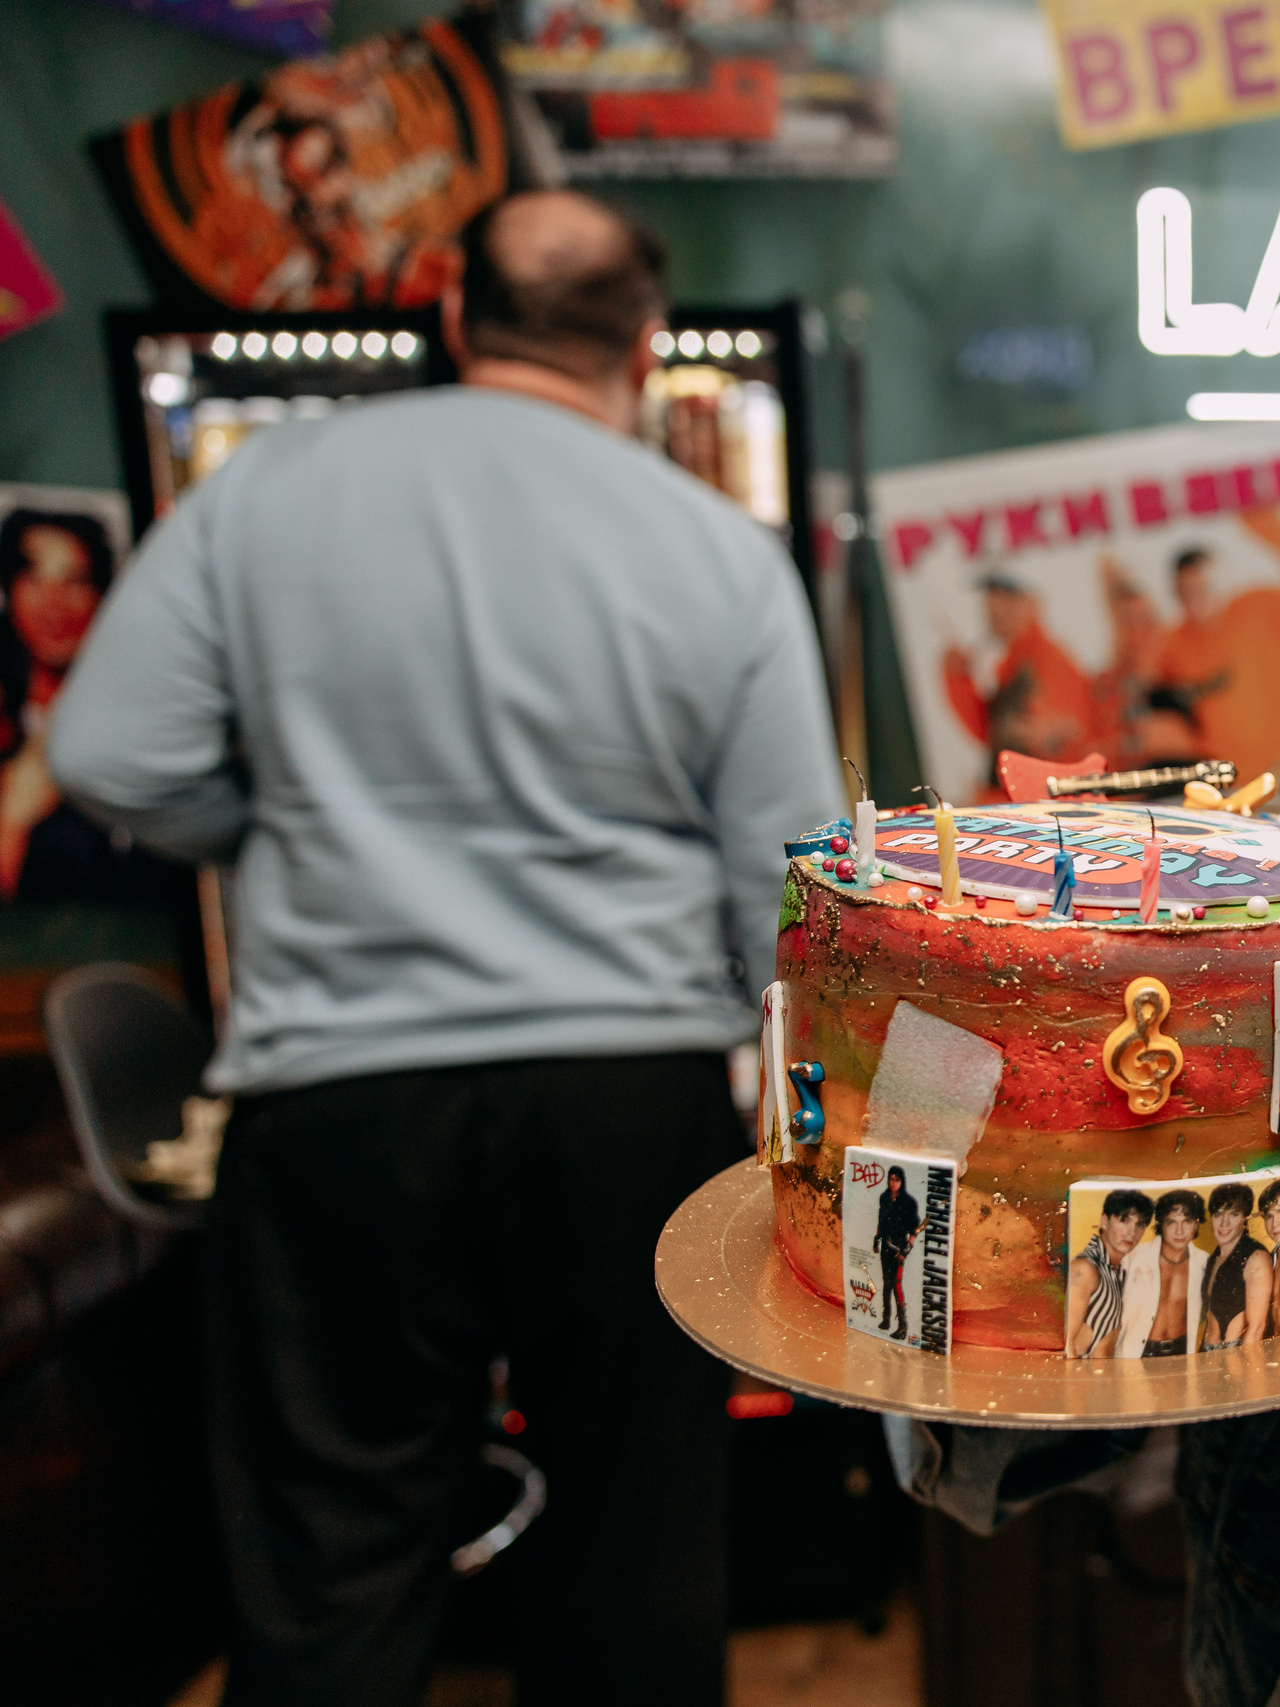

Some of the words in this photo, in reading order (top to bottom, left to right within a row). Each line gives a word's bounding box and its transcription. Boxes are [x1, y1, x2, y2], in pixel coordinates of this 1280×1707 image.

[890, 488, 1111, 573] РУКИ
[882, 832, 1127, 875] PARTY
[850, 1161, 885, 1189] BAD
[924, 1165, 953, 1257] MICHAEL
[921, 1259, 948, 1355] JACKSON
